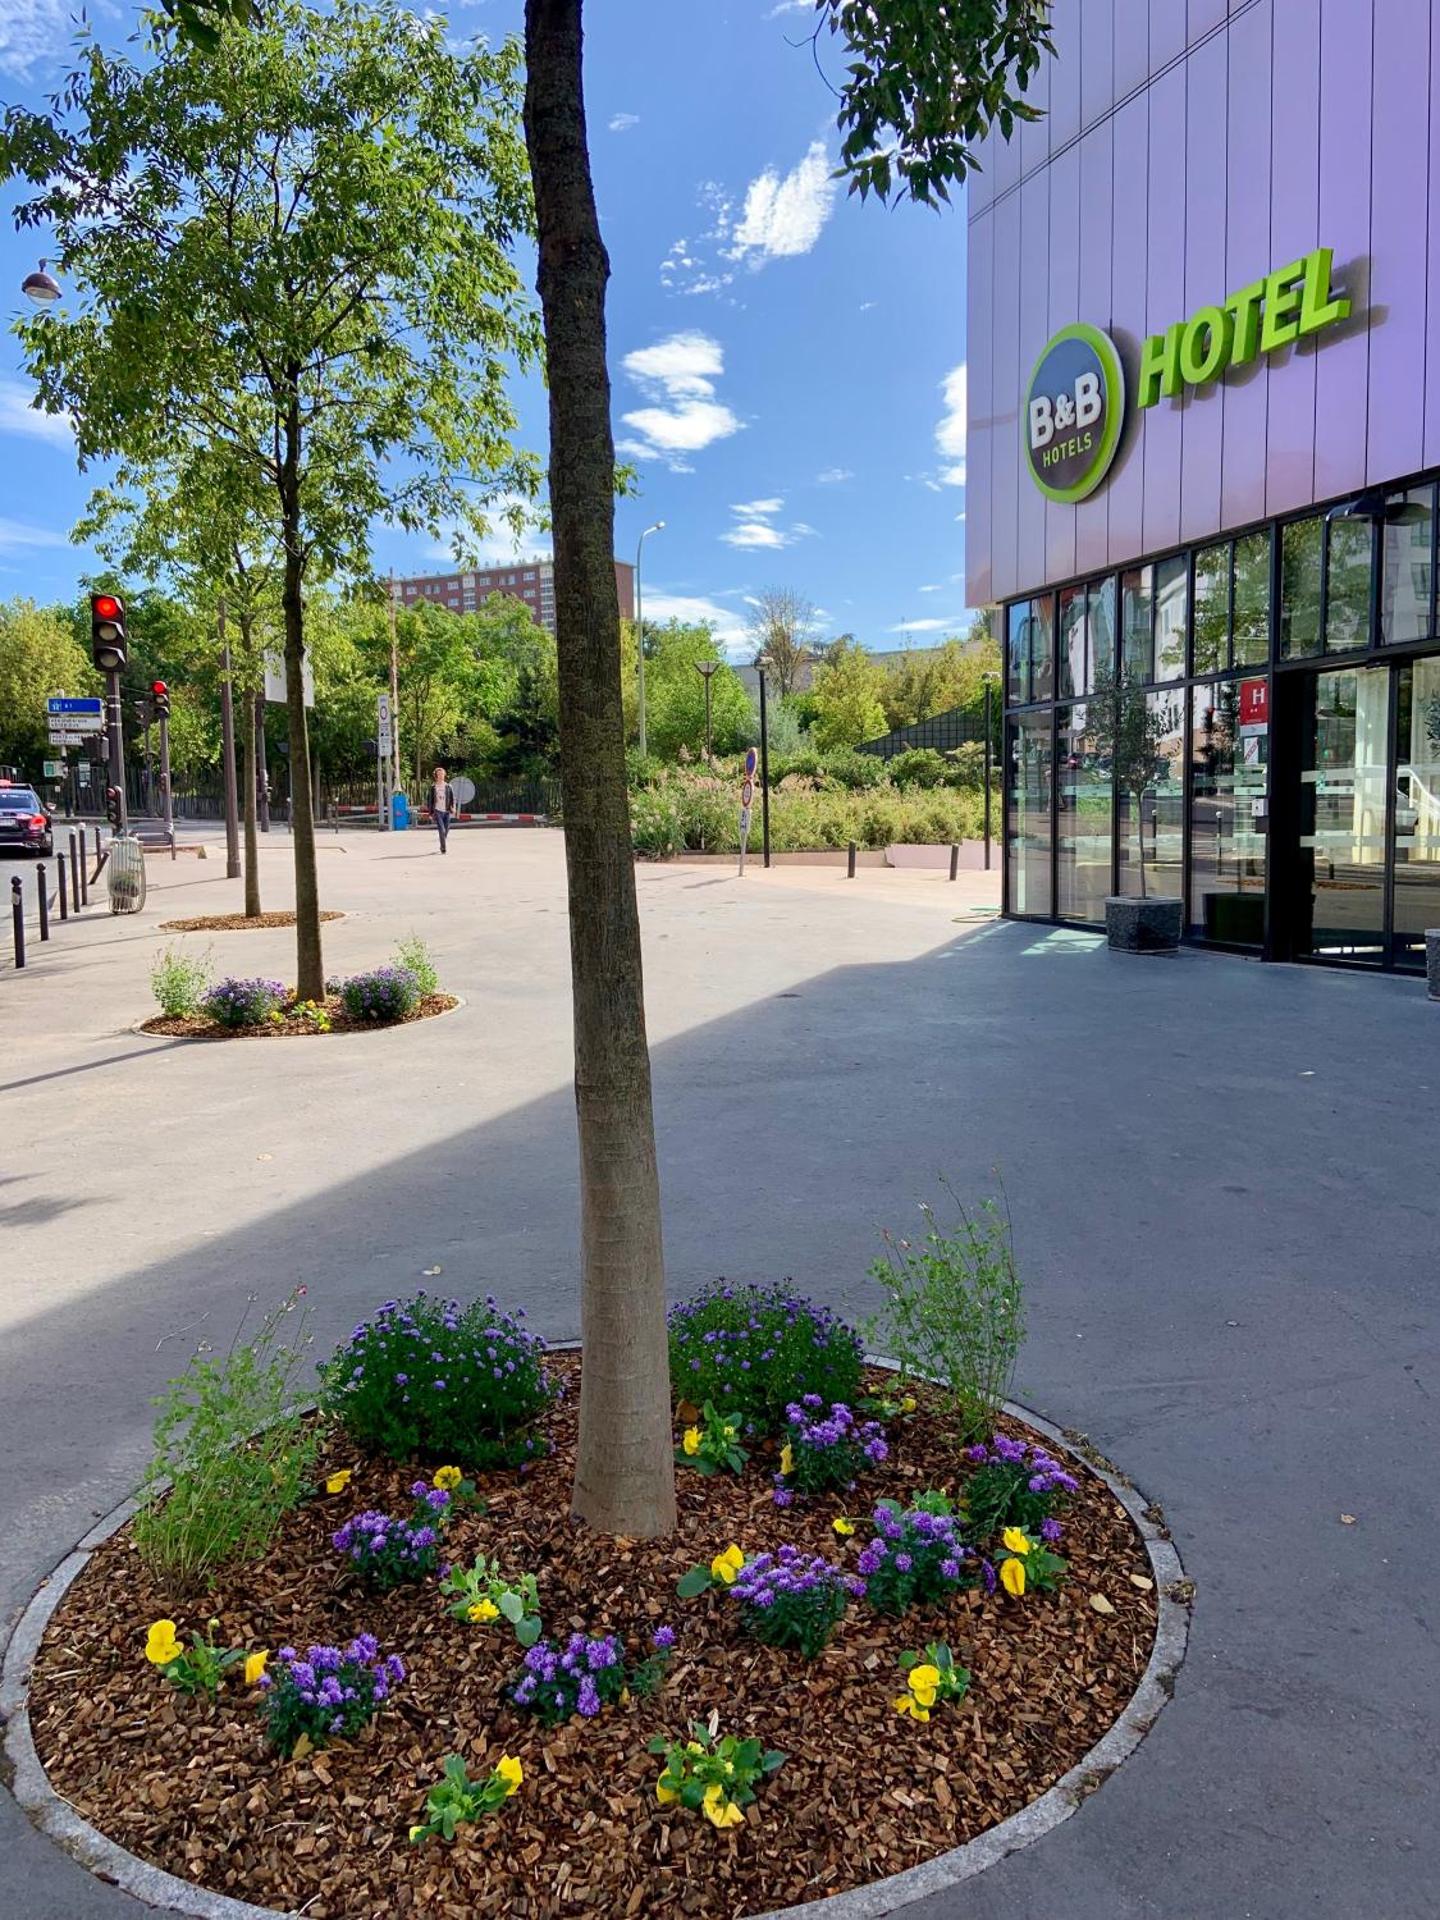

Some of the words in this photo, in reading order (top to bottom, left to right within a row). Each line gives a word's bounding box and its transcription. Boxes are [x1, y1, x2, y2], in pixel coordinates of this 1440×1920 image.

[1138, 248, 1351, 408] HOTEL
[1029, 372, 1102, 450] B&B
[1042, 432, 1092, 468] HOTELS
[1252, 687, 1265, 705] H
